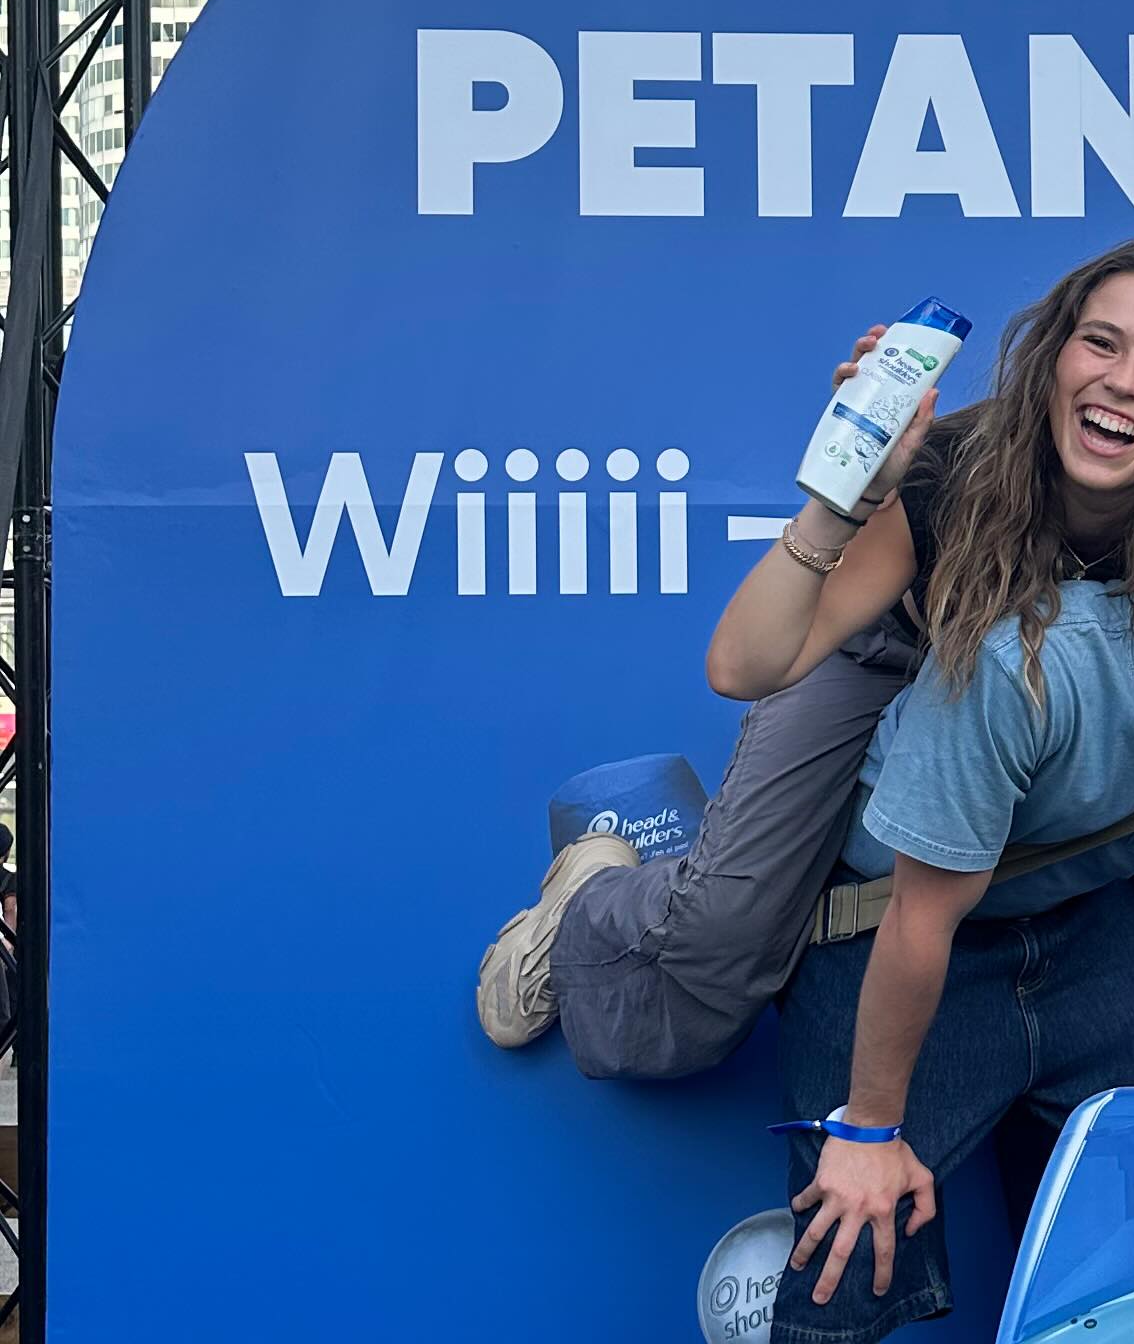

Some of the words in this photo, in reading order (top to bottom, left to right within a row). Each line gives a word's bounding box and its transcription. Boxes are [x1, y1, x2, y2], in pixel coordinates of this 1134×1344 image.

[244, 448, 690, 597] Wiiiii
[621, 807, 668, 837] head
[667, 809, 680, 823] &
[629, 825, 683, 849] ulders
